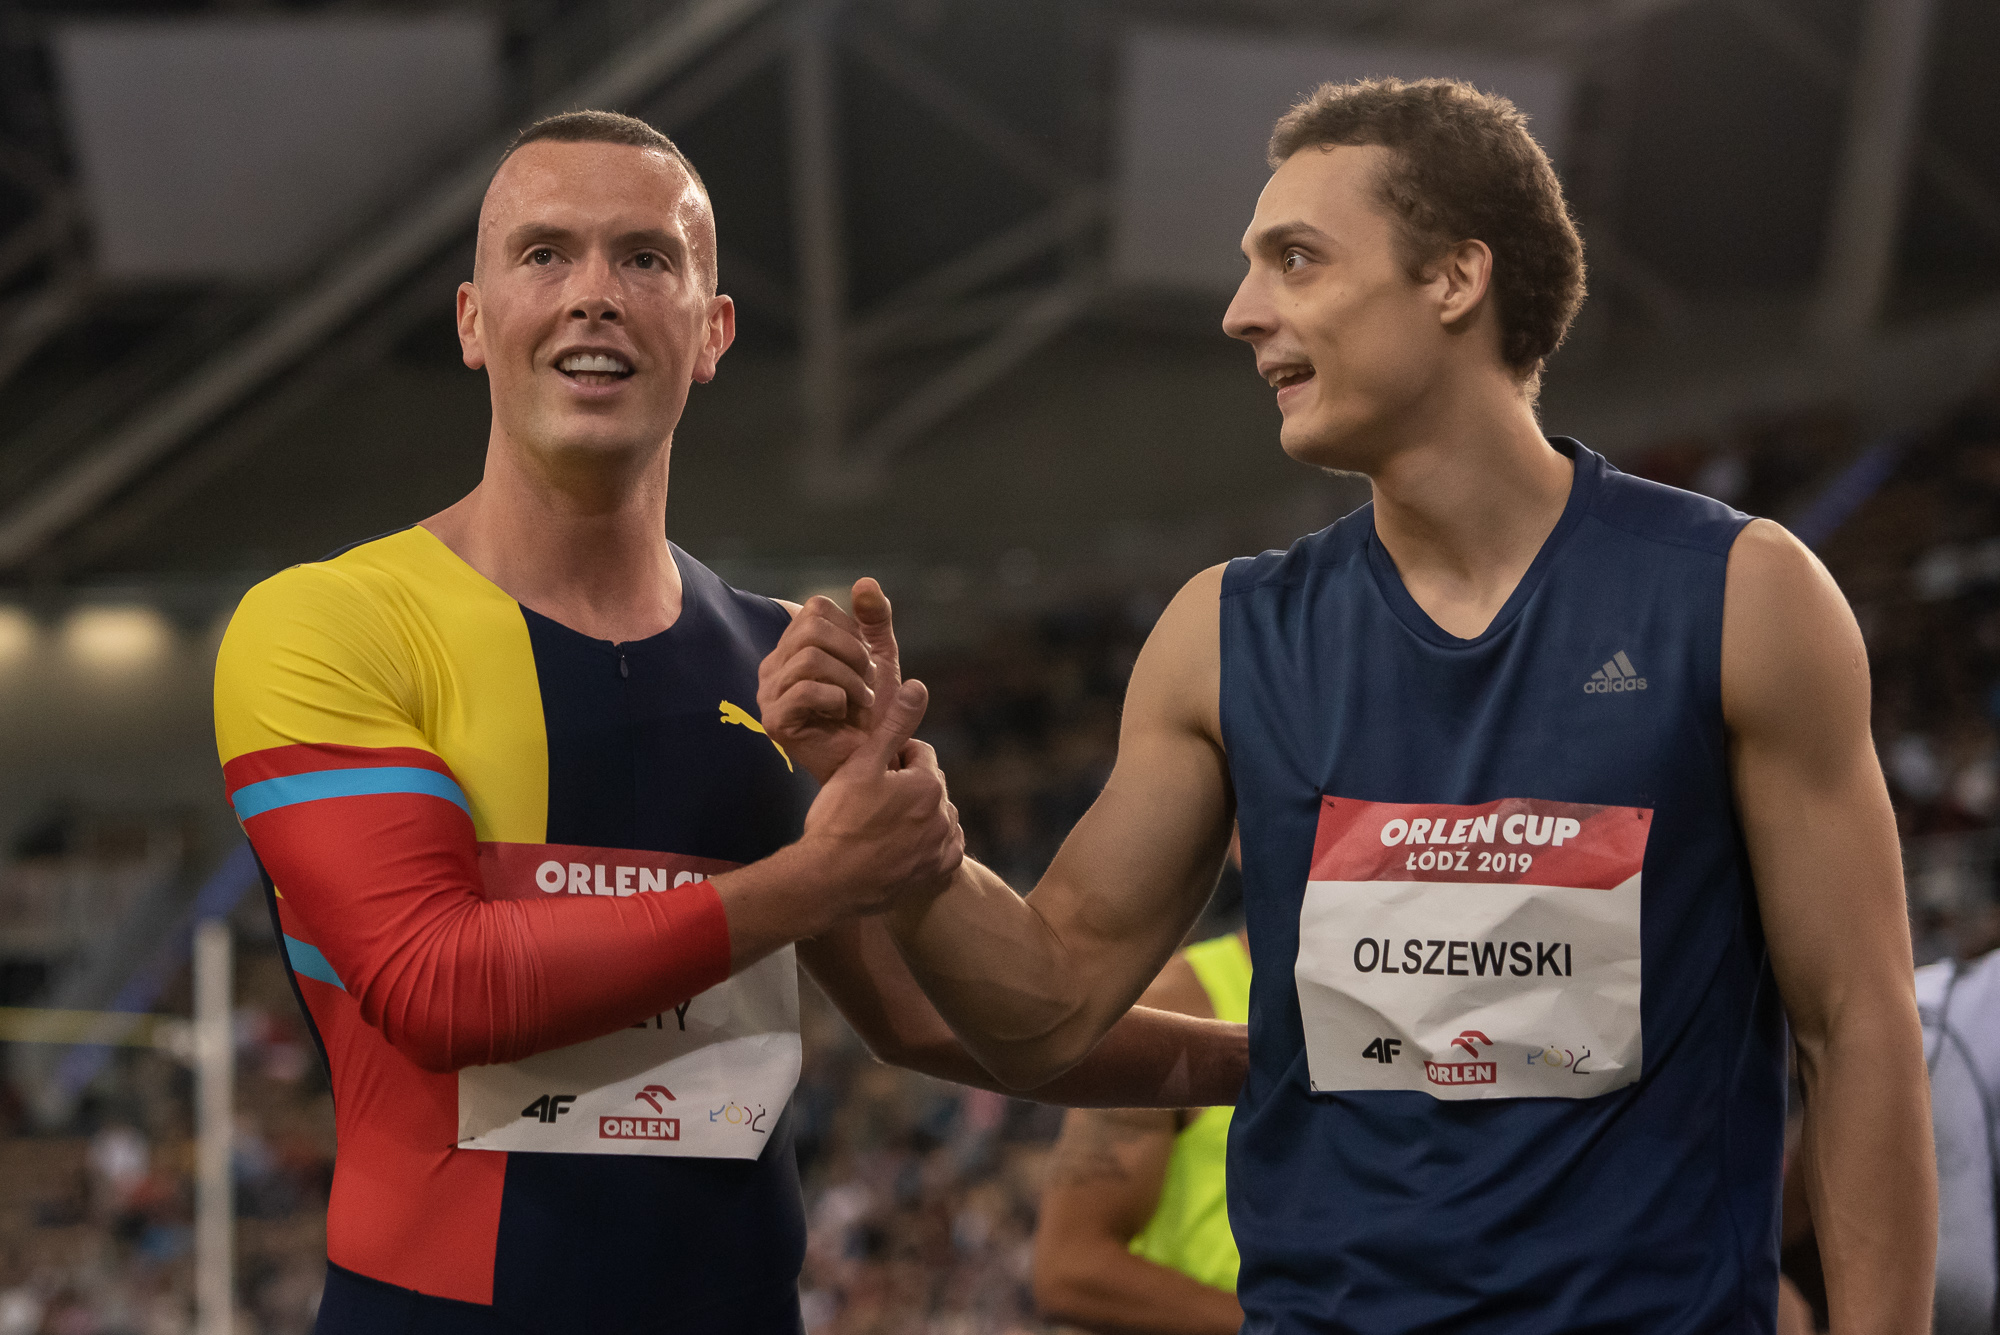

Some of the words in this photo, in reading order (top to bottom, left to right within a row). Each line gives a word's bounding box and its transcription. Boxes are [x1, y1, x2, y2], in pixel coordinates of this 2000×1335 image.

[1583, 676, 1648, 694] adidas
[1380, 814, 1498, 847] ORLEN
[1502, 813, 1581, 847] CUP
[1405, 846, 1469, 872] ŁÓDŹ
[1477, 852, 1533, 873] 2019
[535, 860, 667, 898] ORLEN
[1353, 937, 1572, 977] OLSZEWSKI
[1362, 1037, 1402, 1064] 4F
[1429, 1063, 1492, 1083] ORLEN
[521, 1094, 578, 1123] 4F
[603, 1119, 676, 1138] ORLEN
